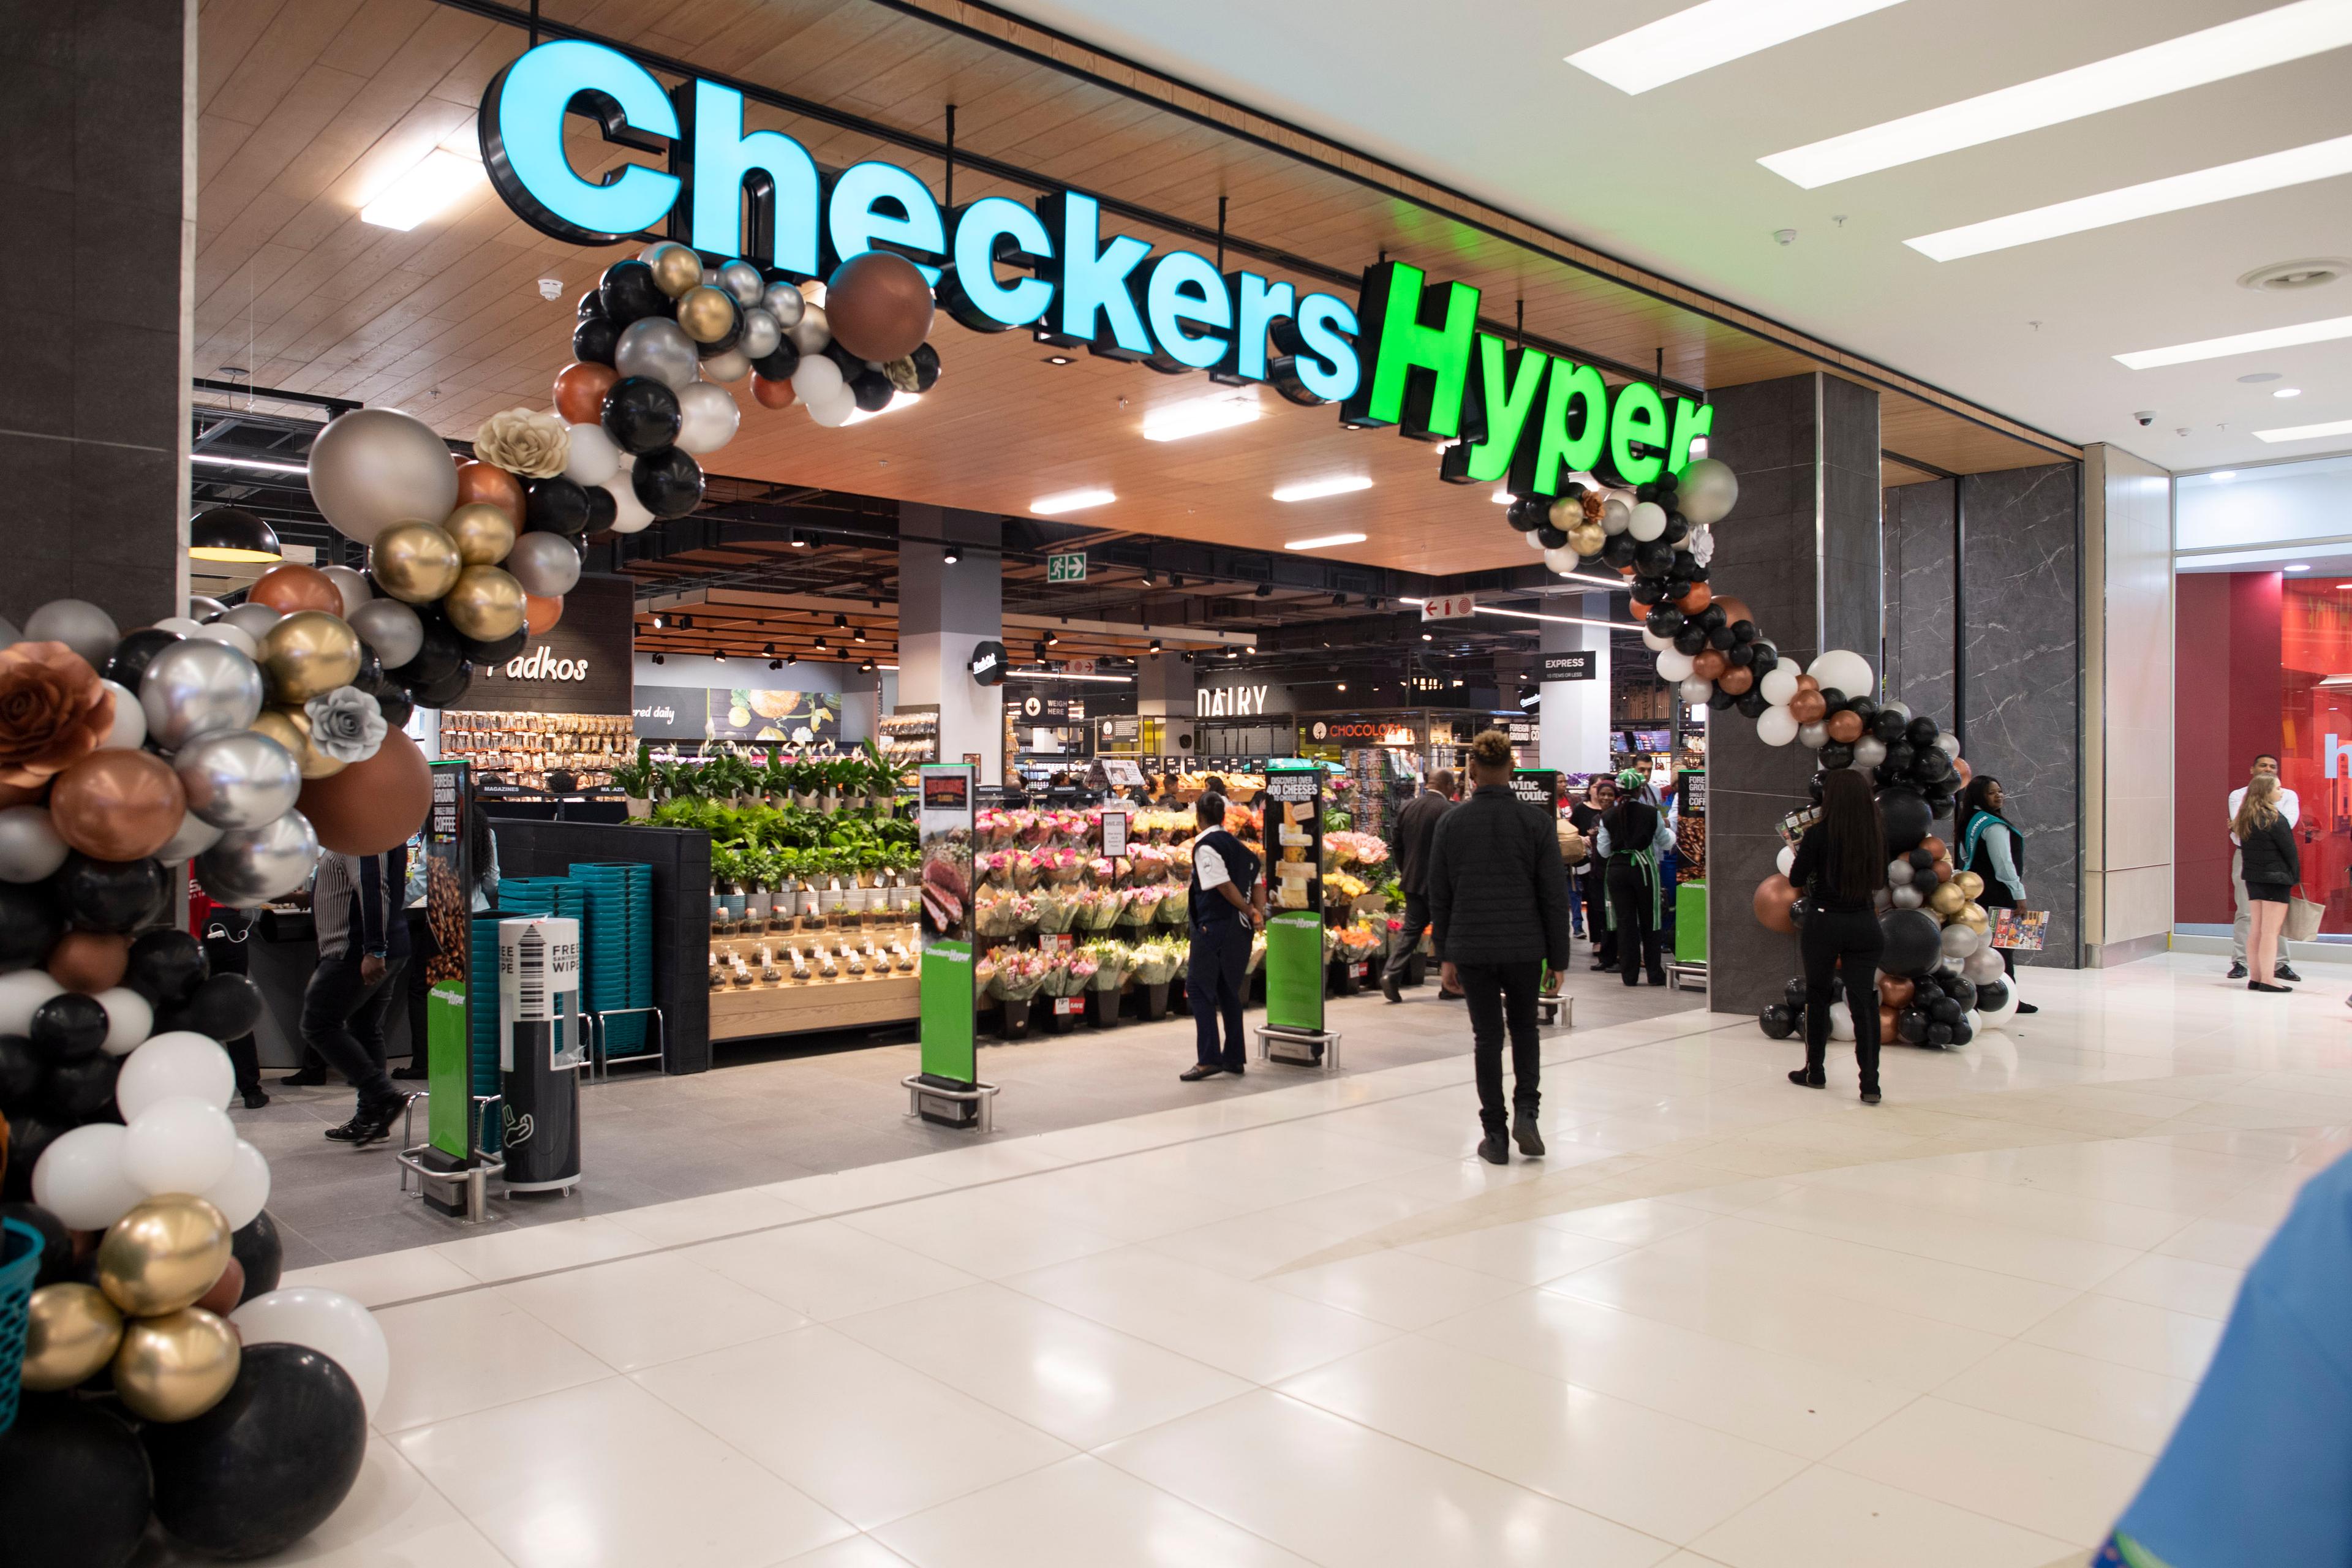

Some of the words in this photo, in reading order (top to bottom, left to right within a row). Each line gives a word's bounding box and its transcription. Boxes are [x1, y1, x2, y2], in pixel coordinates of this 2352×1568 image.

[499, 39, 1361, 403] Checkers
[1368, 260, 1714, 496] Hyper
[486, 646, 589, 681] adkos
[1545, 658, 1585, 668] EXPRESS
[1197, 685, 1268, 717] DAIRY
[653, 706, 675, 725] daily
[1330, 723, 1403, 737] CHOCOLOZA
[1509, 723, 1529, 732] FOREIGN
[1509, 733, 1529, 741] GROUND
[1267, 785, 1281, 795] 400
[1283, 783, 1318, 795] CHEESES
[1509, 776, 1539, 790] wine
[1515, 791, 1550, 801] route
[1689, 797, 1705, 806] COFF
[434, 816, 456, 832] COFFEE
[1970, 815, 1989, 836] SERVICE
[552, 943, 579, 956] FREE
[552, 960, 579, 973] WIPE
